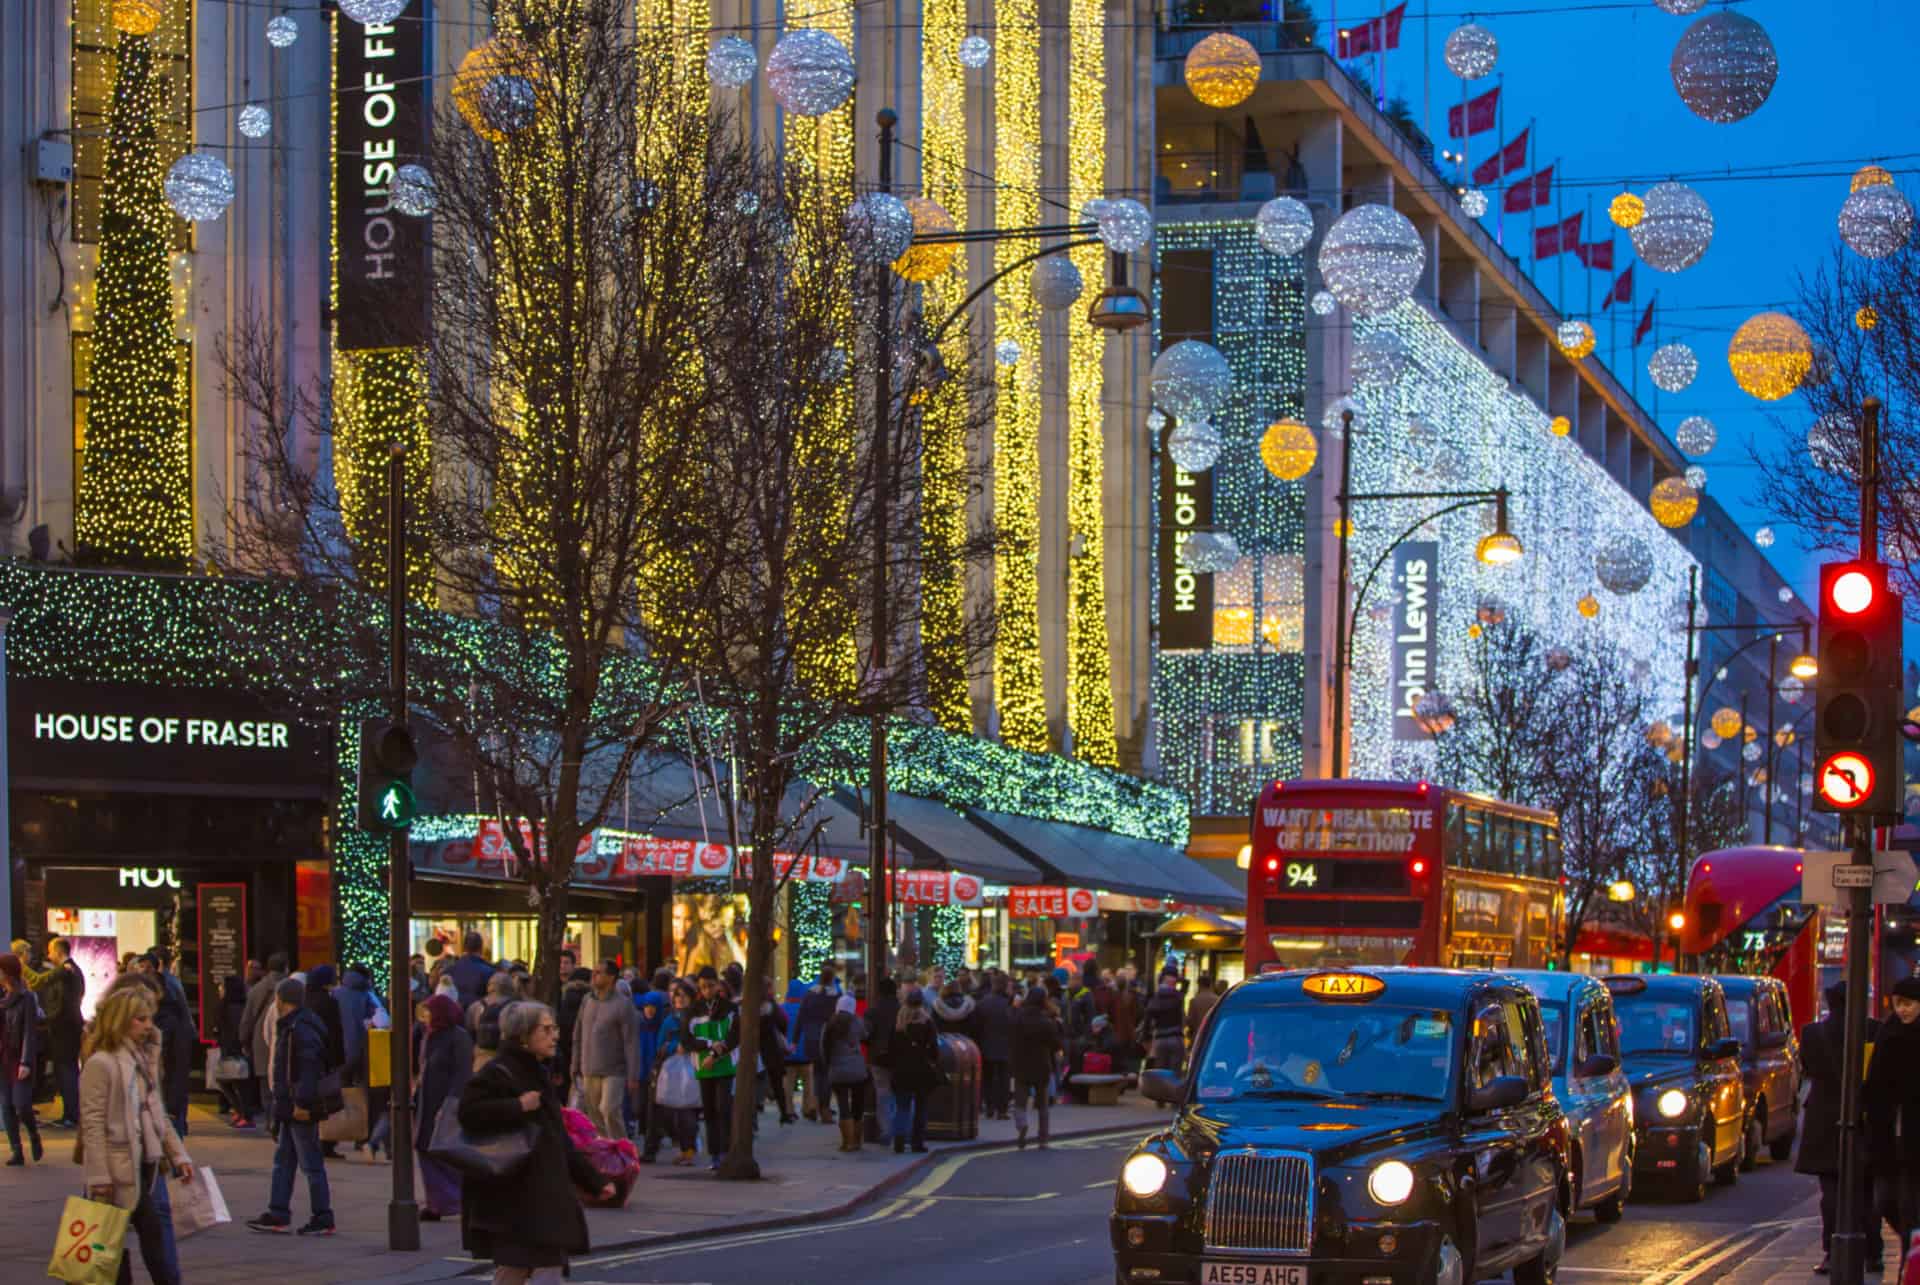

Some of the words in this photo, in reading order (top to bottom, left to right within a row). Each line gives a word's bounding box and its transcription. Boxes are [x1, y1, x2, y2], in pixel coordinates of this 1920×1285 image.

[364, 73, 395, 126] OF
[364, 139, 396, 279] HOUSE
[1175, 492, 1196, 525] OF
[1396, 559, 1428, 643] Lewis
[34, 713, 134, 742] HOUSE
[140, 717, 180, 743] OF
[186, 719, 289, 748] FRASER
[1263, 809, 1312, 827] WANT
[1333, 810, 1375, 828] REAL
[1382, 809, 1433, 829] TASTE
[1277, 832, 1298, 849] OF
[1286, 863, 1318, 887] 94
[1014, 898, 1066, 914] SALE
[1743, 932, 1766, 951] 73
[1319, 979, 1366, 993] TAXI
[1208, 1265, 1257, 1284] AE59
[1263, 1267, 1300, 1285] AHG
